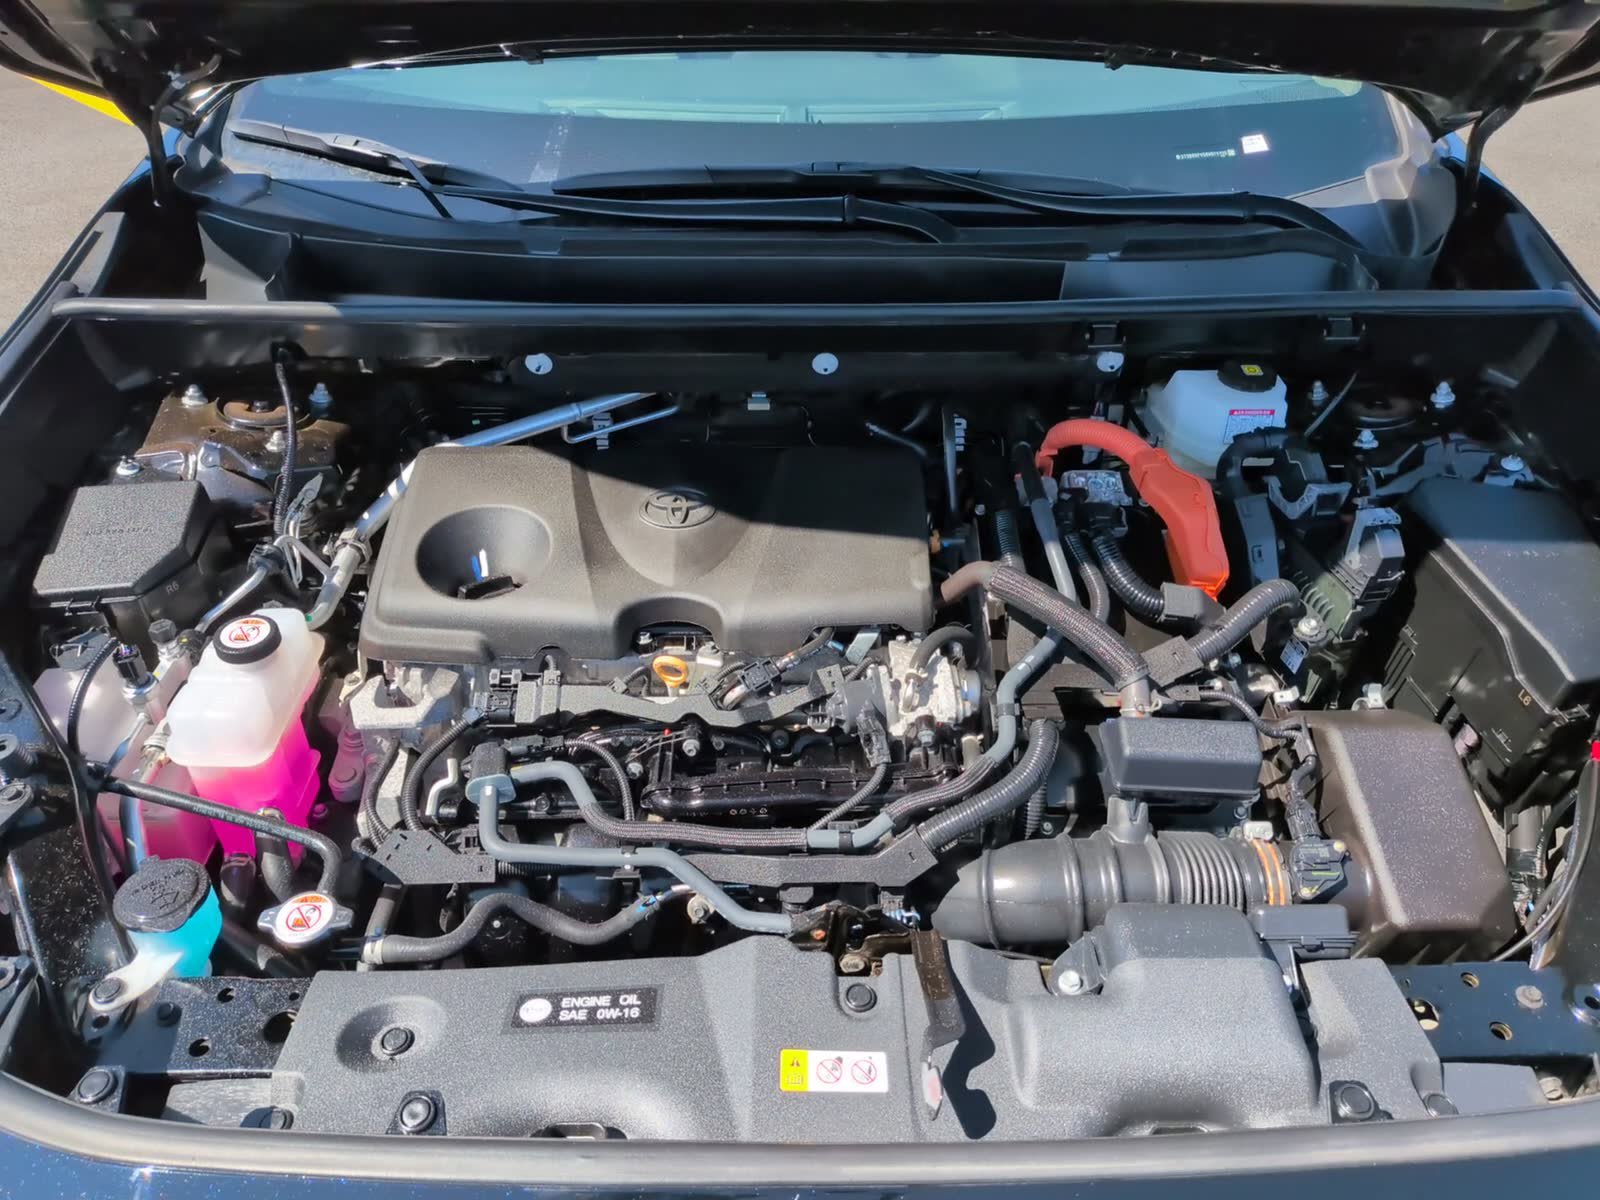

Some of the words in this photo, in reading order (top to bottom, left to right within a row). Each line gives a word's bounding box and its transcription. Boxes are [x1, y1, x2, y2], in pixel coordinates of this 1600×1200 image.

[561, 995, 611, 1008] ENGINE
[619, 994, 641, 1006] OIL
[559, 1009, 588, 1021] SAE
[596, 1007, 640, 1020] 0W-16
